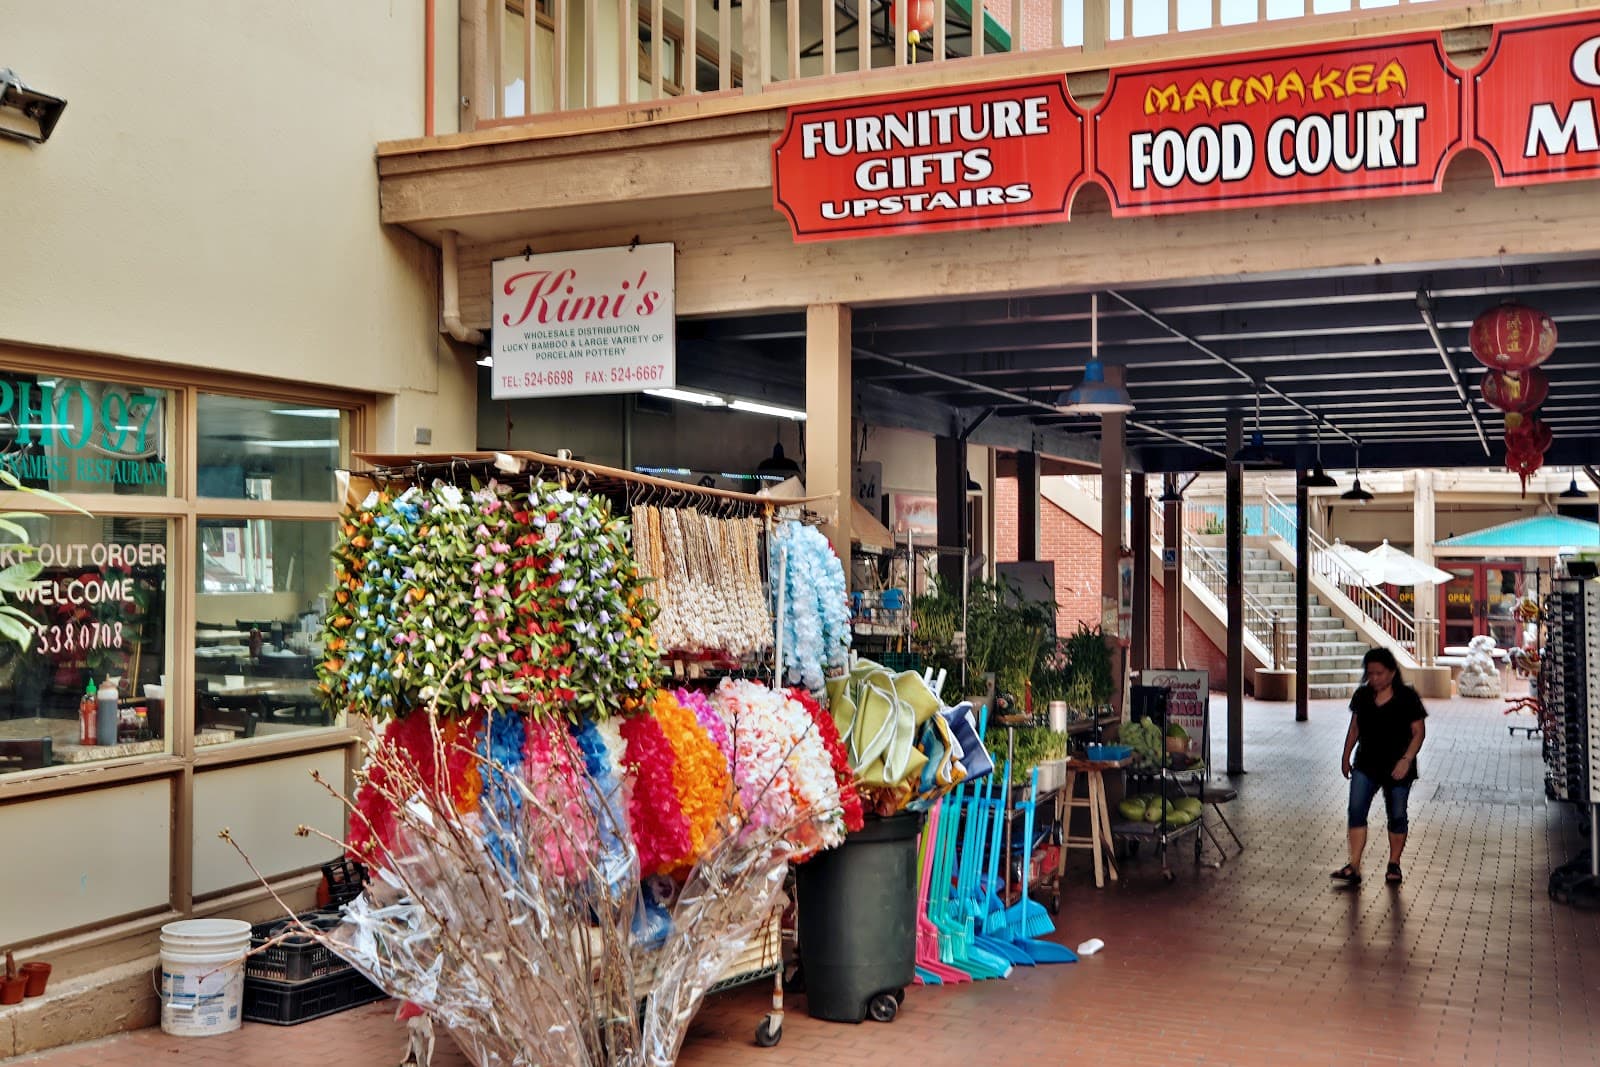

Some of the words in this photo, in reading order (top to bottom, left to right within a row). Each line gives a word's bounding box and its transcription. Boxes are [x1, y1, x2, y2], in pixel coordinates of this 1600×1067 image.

[1143, 58, 1408, 115] MAUNAKEA
[802, 96, 1049, 159] FURNITURE
[1130, 122, 1254, 190] FOOD
[1267, 104, 1427, 179] COURT
[855, 148, 993, 192] GIFTS
[821, 183, 1032, 220] UPSTAIRS
[502, 268, 664, 327] Kimi's
[502, 340, 529, 352] LUCKY
[531, 338, 568, 350] BAMBOO
[570, 338, 577, 347] &
[578, 335, 609, 346] LARGE
[611, 333, 649, 345] VARIETY
[651, 333, 664, 342] OF
[524, 327, 575, 340] WHOLESALE
[578, 324, 640, 336] DISTRIBUTION
[535, 348, 583, 360] PORCELAIN
[586, 347, 626, 358] POTTERY
[502, 375, 521, 388] TEL:
[524, 369, 573, 387] 524-6698
[585, 370, 607, 384] FAX:
[610, 364, 665, 383] 524-6667
[101, 392, 157, 453] 97
[0, 453, 70, 481] NAMESE
[77, 457, 166, 486] RESTAURANT
[37, 543, 88, 568] OUT
[90, 543, 166, 567] ORDER
[15, 578, 135, 606] WELCOME
[1448, 593, 1471, 603] OPEN
